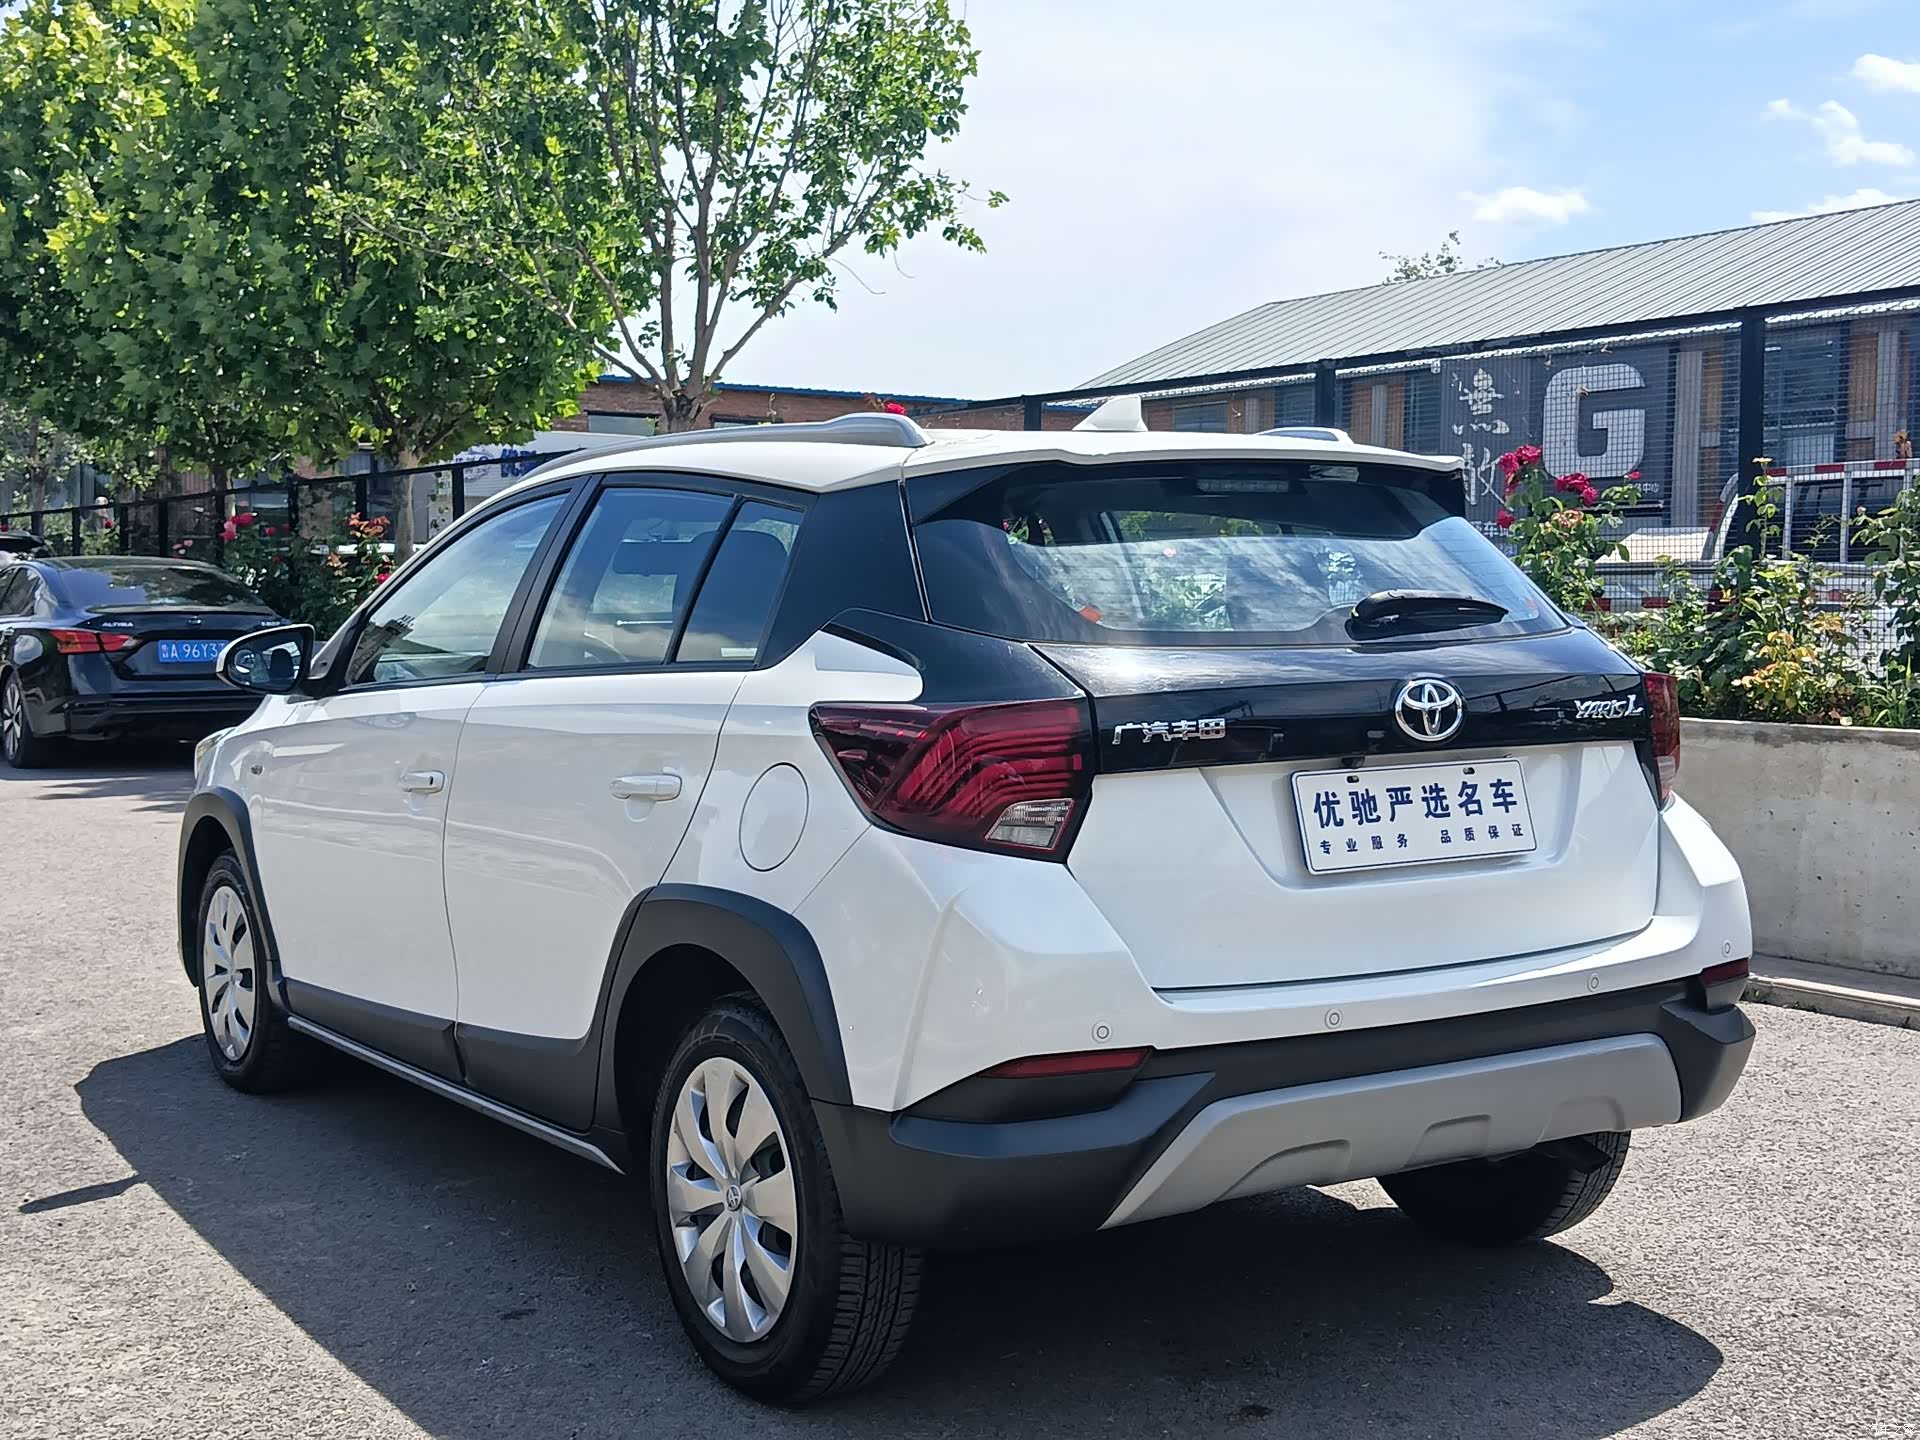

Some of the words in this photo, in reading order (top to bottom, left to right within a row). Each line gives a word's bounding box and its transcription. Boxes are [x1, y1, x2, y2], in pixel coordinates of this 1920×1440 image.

[1543, 364, 1645, 478] G
[1574, 699, 1627, 719] YARIS
[1112, 718, 1226, 745] 广汽丰田
[1313, 778, 1518, 829] 优驰严选名车
[1319, 833, 1409, 856] 专业服务
[1440, 823, 1524, 844] 品质保证
